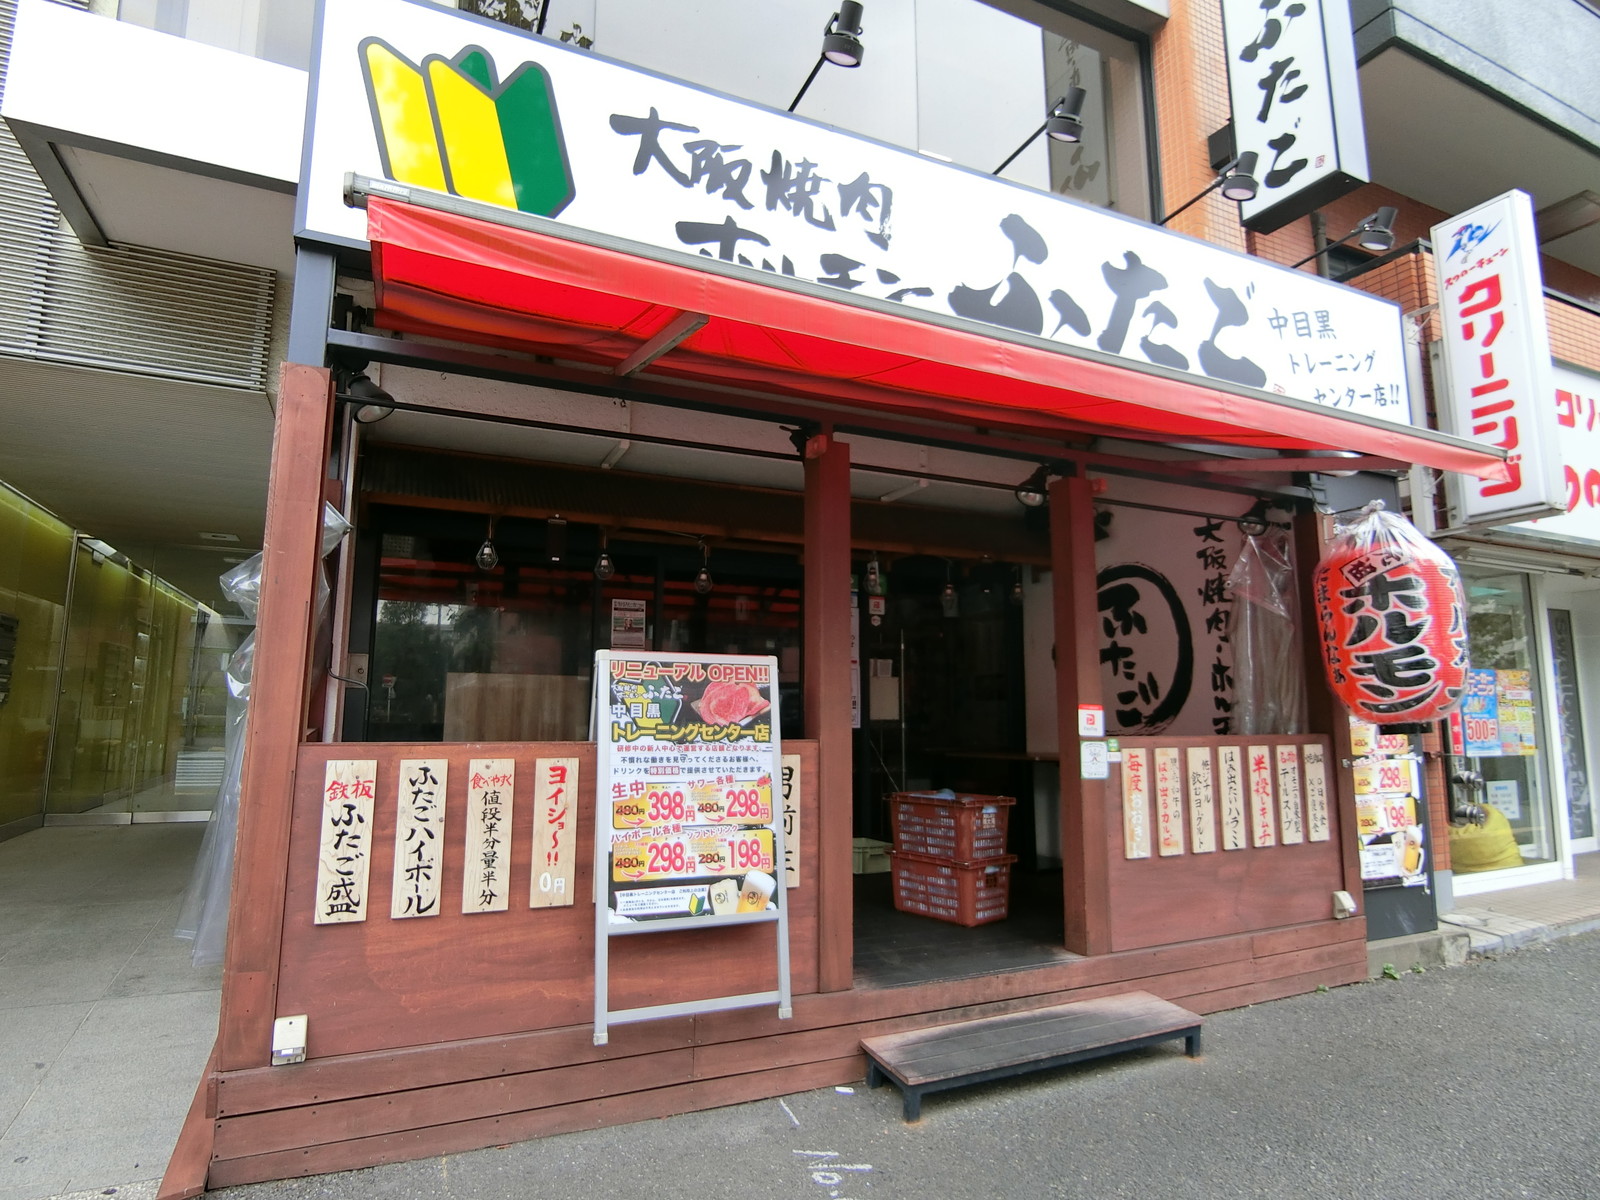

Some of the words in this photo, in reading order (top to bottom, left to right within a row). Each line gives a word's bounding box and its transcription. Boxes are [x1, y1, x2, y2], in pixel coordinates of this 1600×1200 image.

[609, 106, 894, 252] 大阪焼肉
[1267, 307, 1338, 341] 中目黒
[1288, 350, 1377, 376] トレーニング
[1313, 383, 1400, 408] センター店!!
[1457, 273, 1523, 498] クリーニング
[1555, 387, 1600, 433] クリ
[1338, 572, 1443, 716] ホルモン
[610, 660, 706, 682] リニューアル
[708, 663, 770, 683] OPEN!!
[612, 702, 661, 719] 中目黒
[611, 720, 771, 743] トレーニングセンター店
[325, 779, 374, 802] 鉄板
[469, 771, 513, 790] 食べやすく
[611, 779, 647, 800] 生中
[687, 774, 736, 790] サワー各種
[1191, 771, 1205, 849] 飲むヨーグルト
[1280, 767, 1292, 831] テールスープ
[610, 823, 684, 844] ハイボール各種
[686, 824, 740, 840] ソフトドリンク
[781, 766, 797, 872] 男前
[402, 766, 437, 915] ふたごハイボール
[478, 789, 503, 907] 値段半分量半分
[324, 803, 365, 917] ふたご盛
[538, 871, 567, 896] 0円
